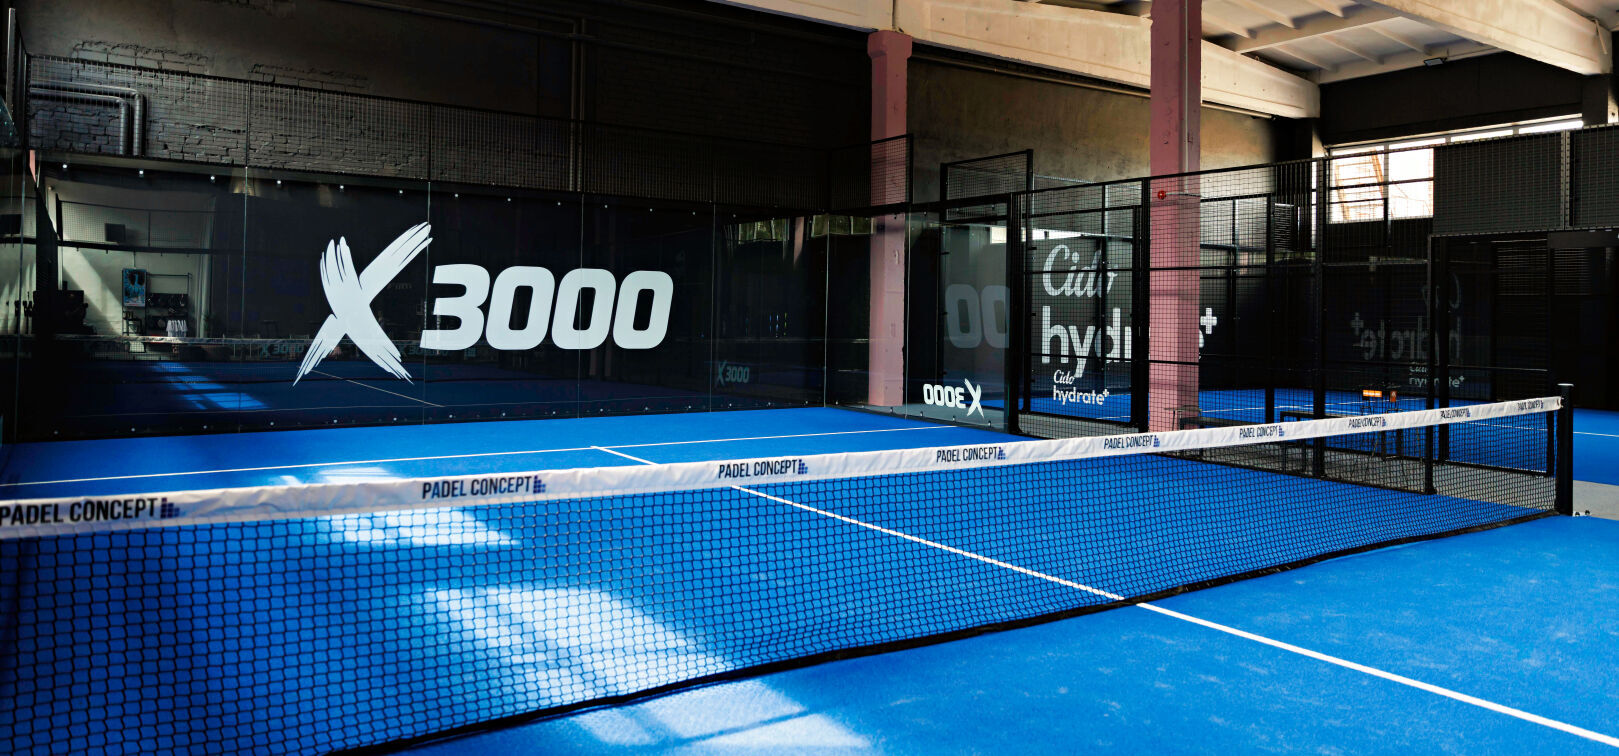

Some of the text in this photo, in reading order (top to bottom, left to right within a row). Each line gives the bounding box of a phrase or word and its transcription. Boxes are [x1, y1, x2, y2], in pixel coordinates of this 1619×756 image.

[1053, 369, 1076, 385] Cido
[1257, 425, 1278, 437] CONCEPT
[1104, 434, 1153, 449] PADEL CONCEPT
[936, 446, 997, 463] PADEL CONCEPT
[719, 459, 797, 479] PADEL CONCEPT
[422, 475, 532, 499] PADEL CONCEPT
[0, 498, 157, 527] PADEL CONCEPT
